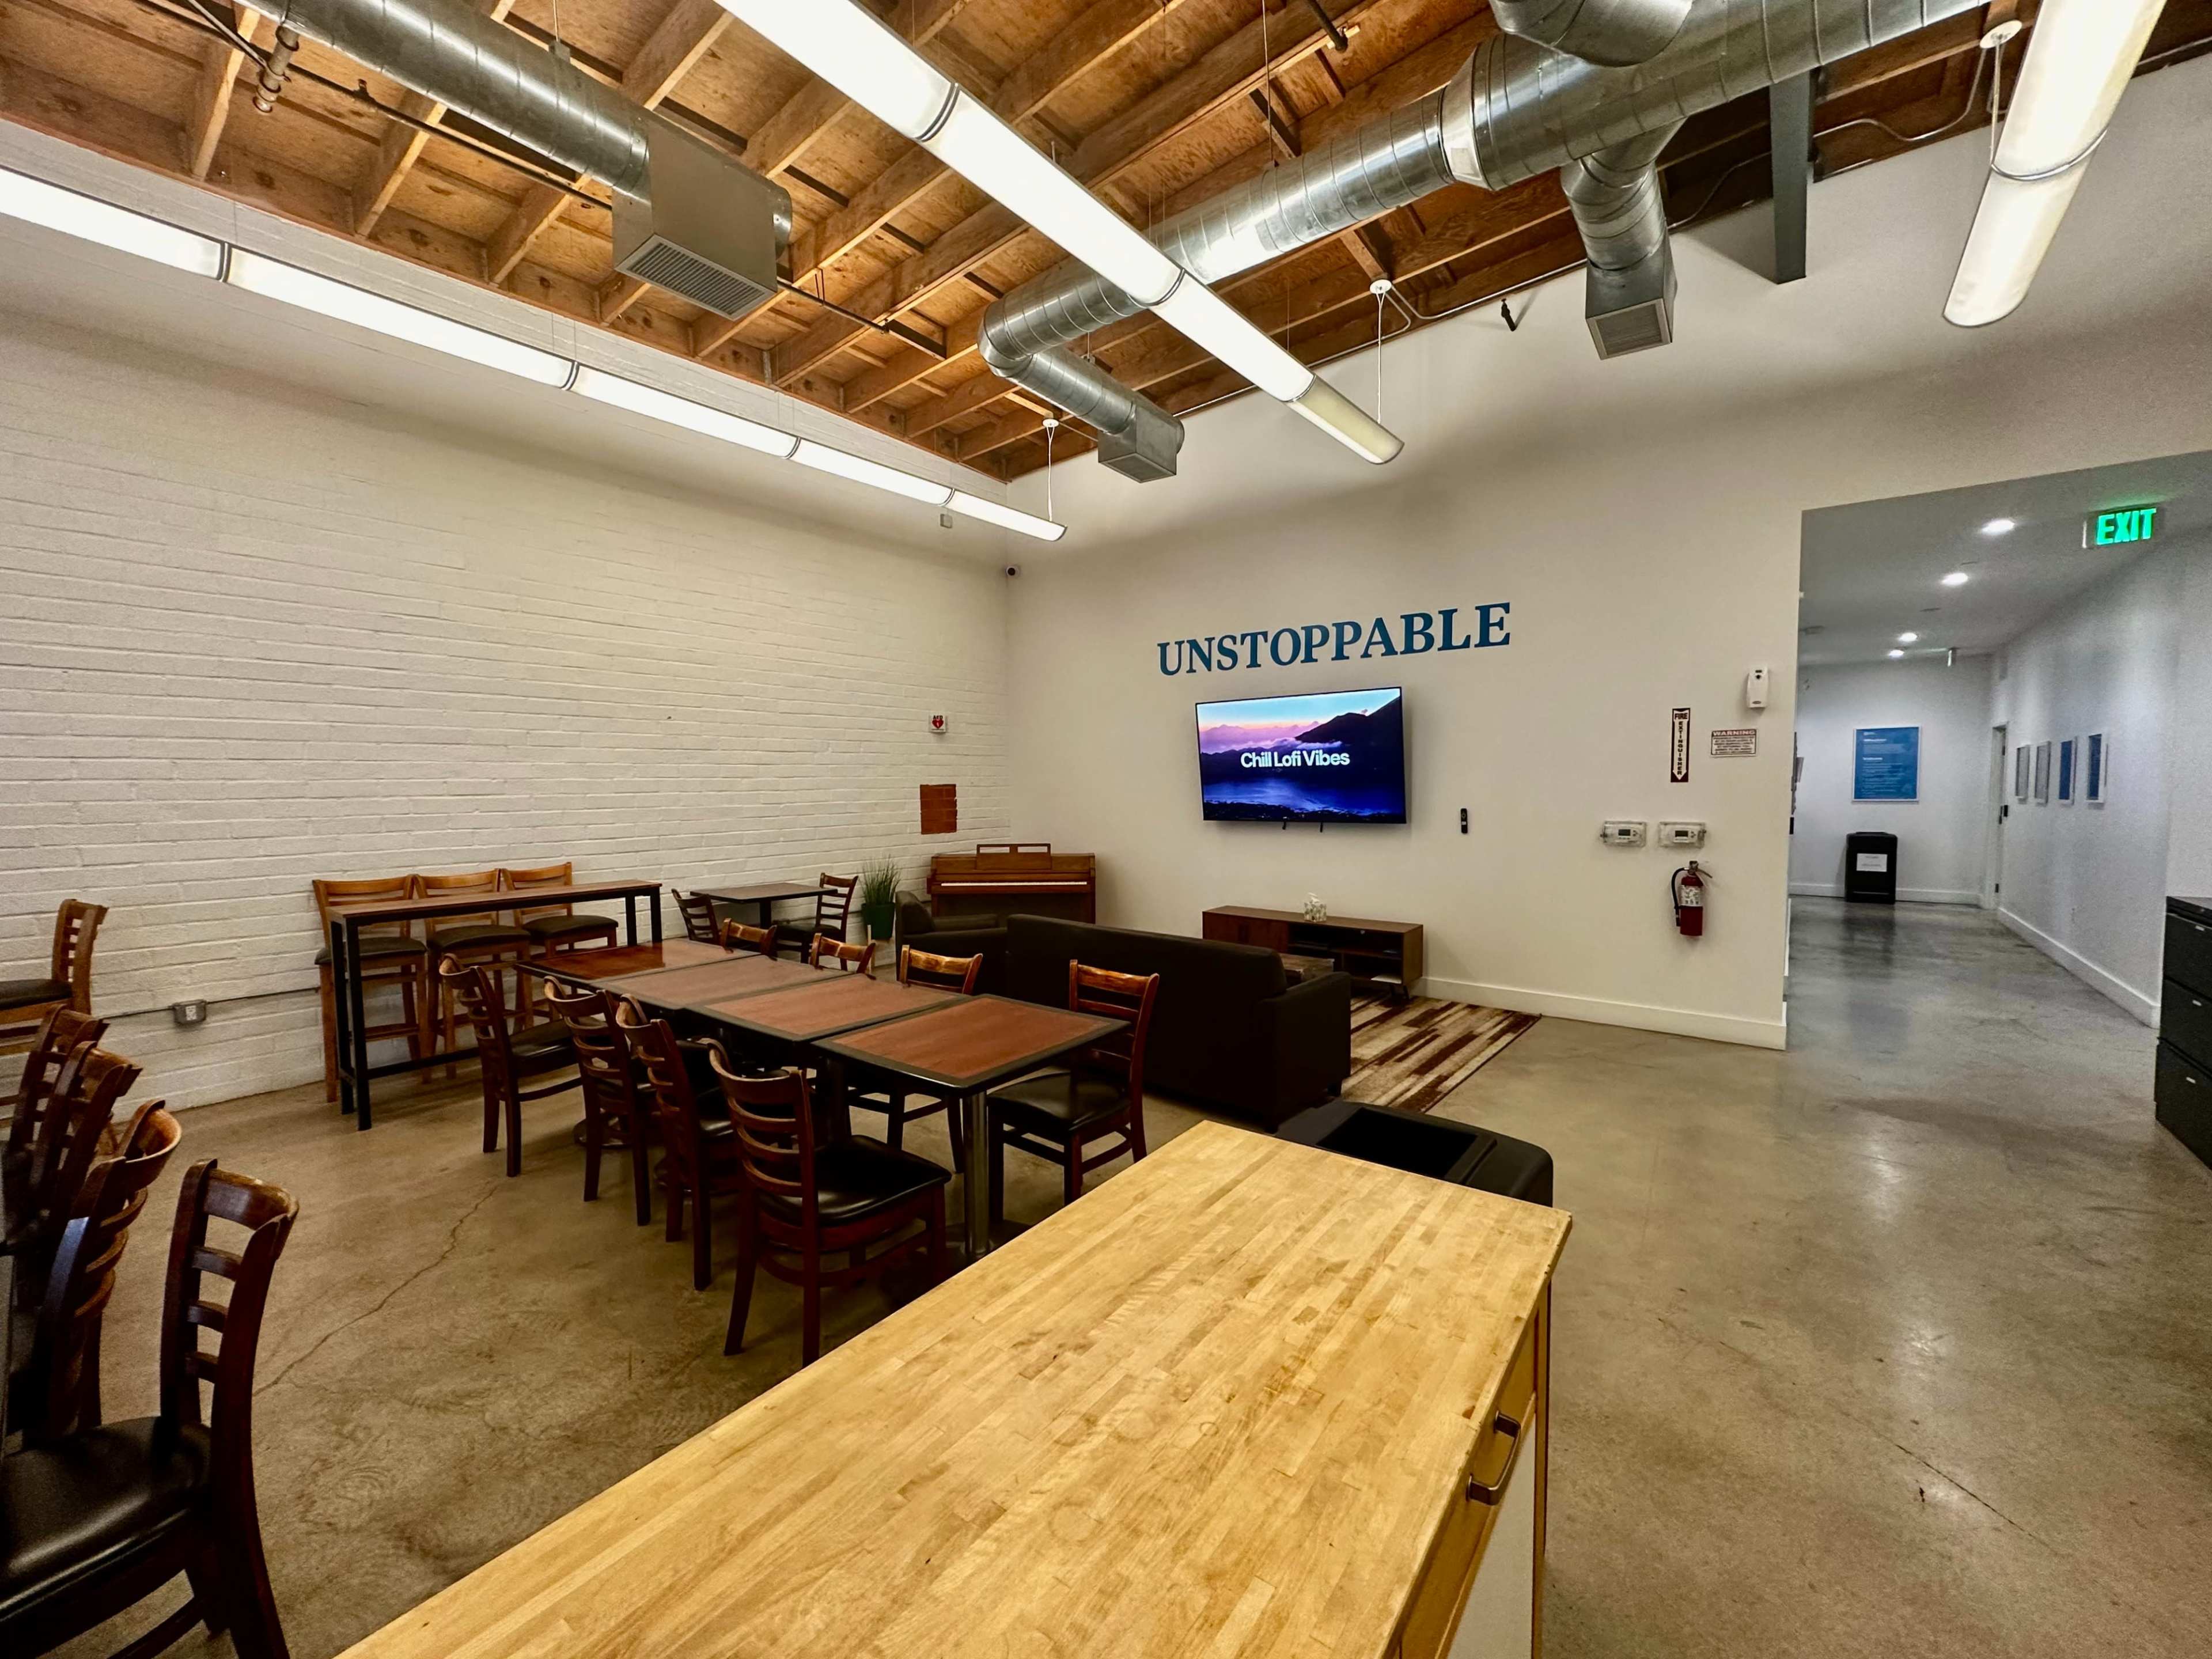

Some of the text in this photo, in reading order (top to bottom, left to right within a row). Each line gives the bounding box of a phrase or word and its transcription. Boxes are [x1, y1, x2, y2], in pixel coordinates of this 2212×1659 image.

[2097, 508, 2157, 545] EXIT
[1157, 602, 1510, 676] UNSTOPPABLE
[1240, 749, 1350, 767] Chill Lofi Vibes
